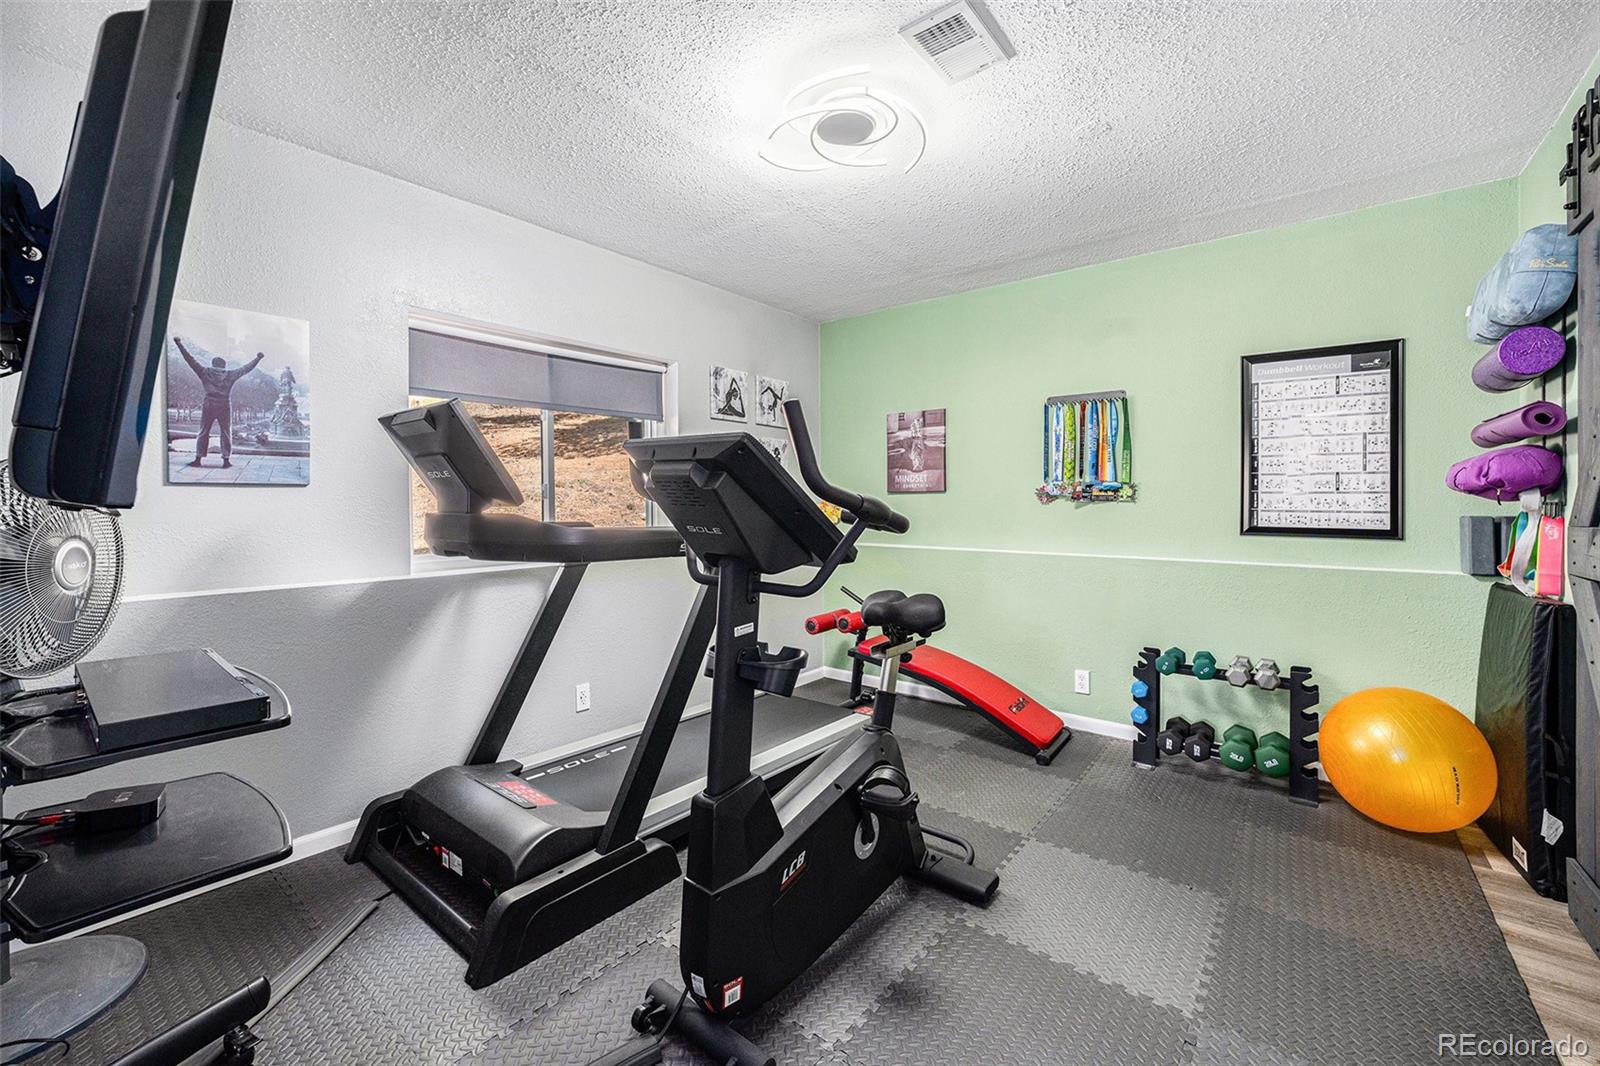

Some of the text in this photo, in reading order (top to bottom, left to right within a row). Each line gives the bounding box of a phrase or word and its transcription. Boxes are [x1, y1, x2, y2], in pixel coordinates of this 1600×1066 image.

[1257, 361, 1345, 376] Dumbbell Workout
[427, 470, 451, 479] SOLE
[895, 474, 928, 483] MINDSET
[686, 525, 723, 535] SOLE
[546, 750, 611, 775] SOLE
[781, 850, 806, 885] LCB
